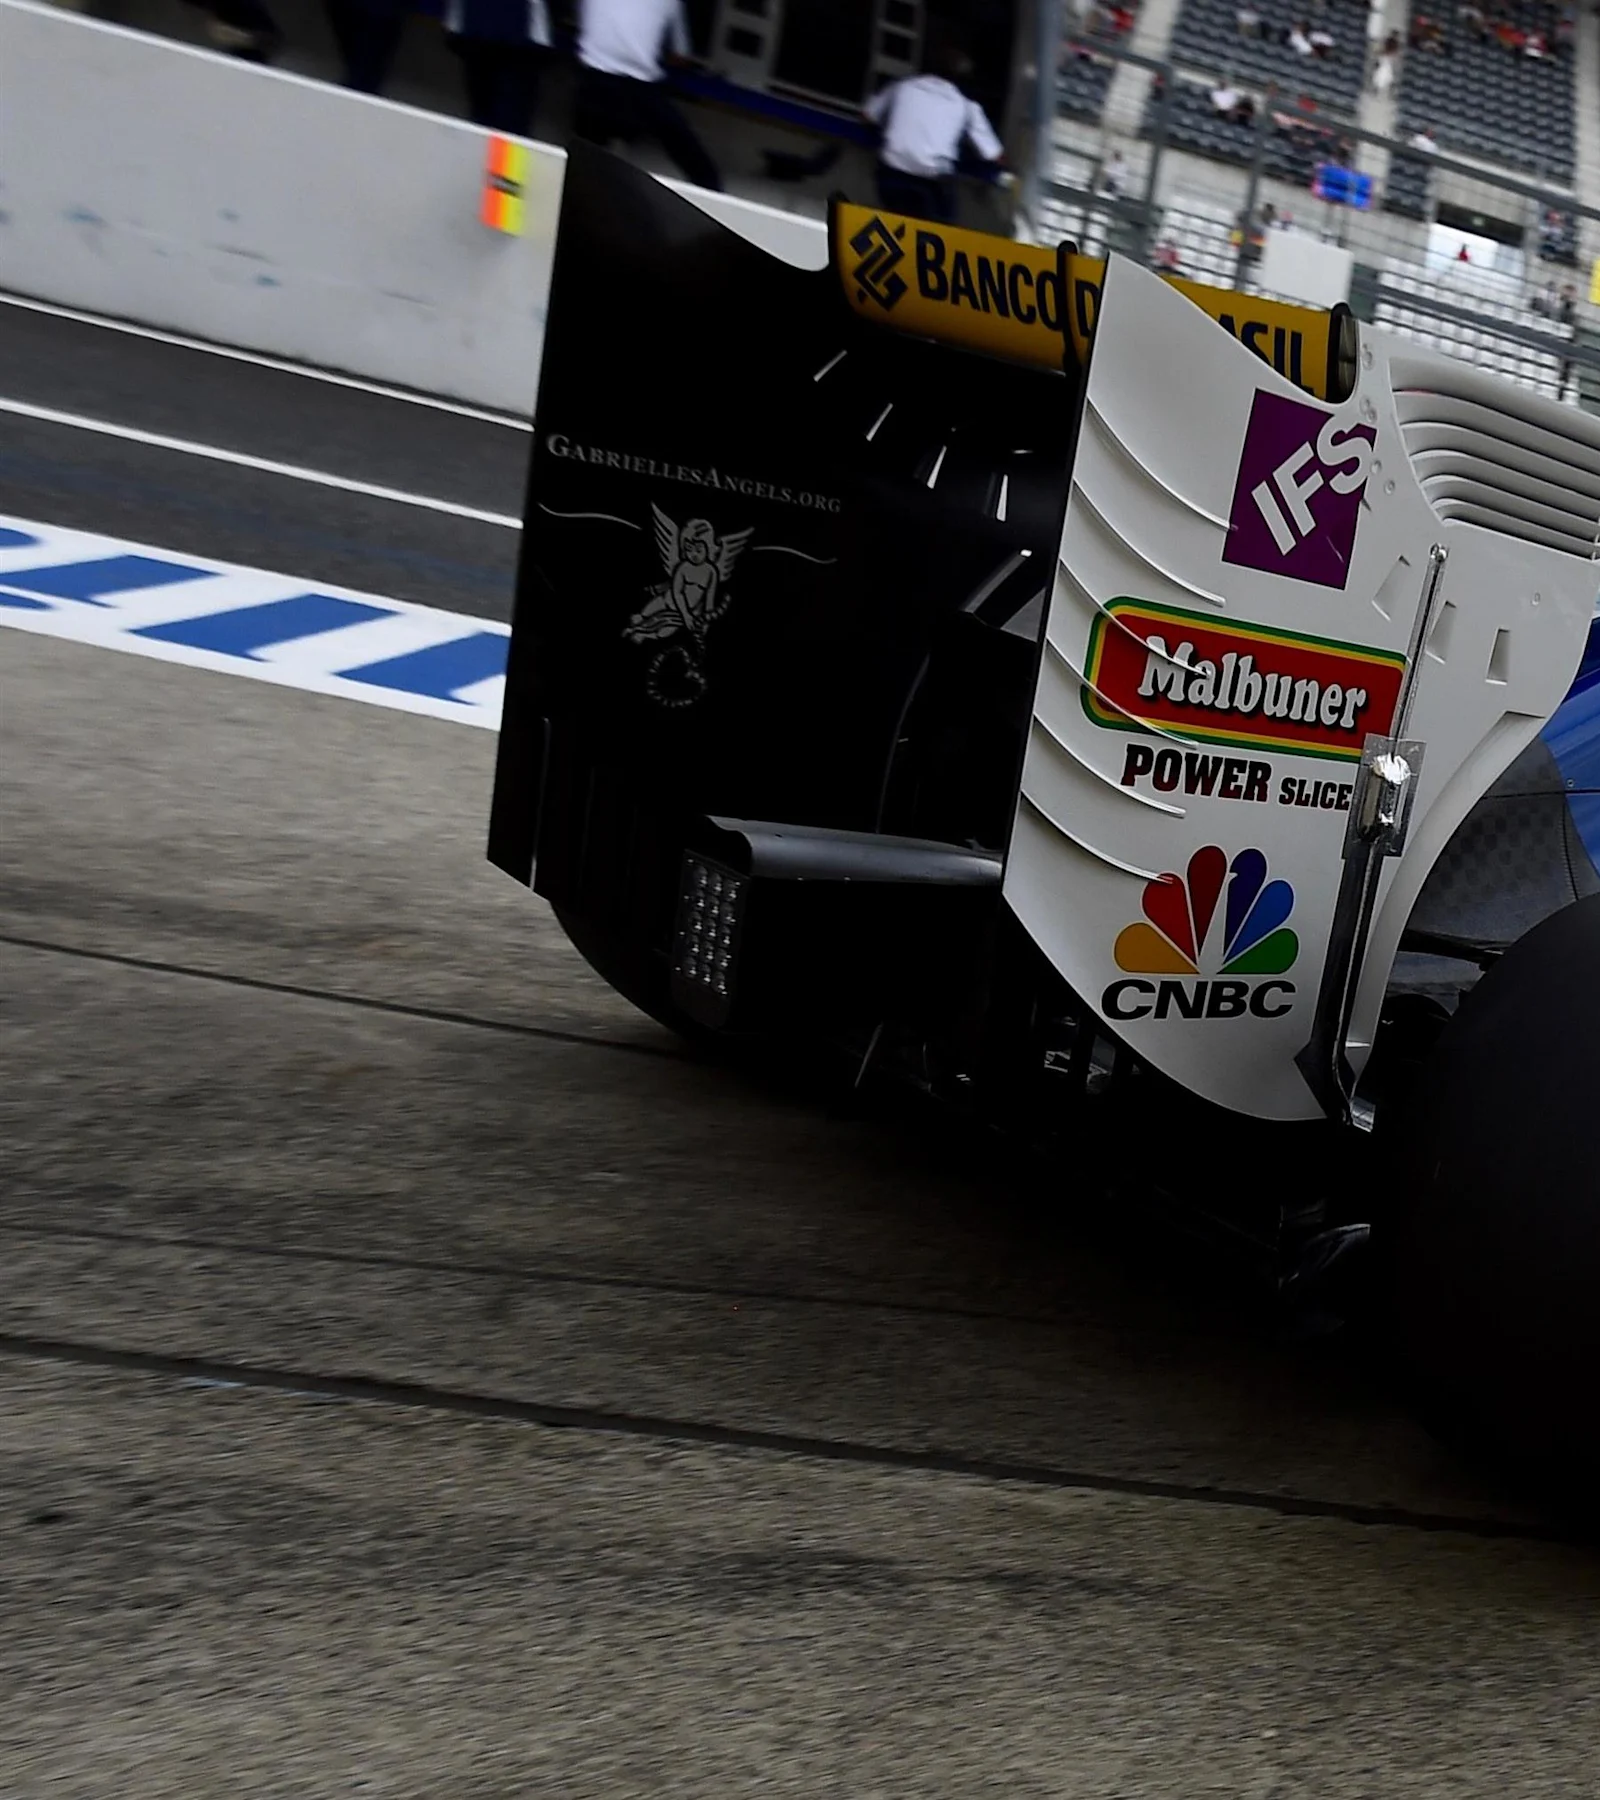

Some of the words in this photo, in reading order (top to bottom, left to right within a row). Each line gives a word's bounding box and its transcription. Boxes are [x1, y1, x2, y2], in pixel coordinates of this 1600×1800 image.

[915, 230, 1062, 332] BANCO
[1078, 279, 1100, 338] D
[1251, 413, 1374, 556] IFS
[1137, 635, 1367, 729] Malbuner
[1121, 743, 1273, 803] POWER
[1278, 777, 1354, 811] SLICE
[1101, 979, 1297, 1021] CNBC
